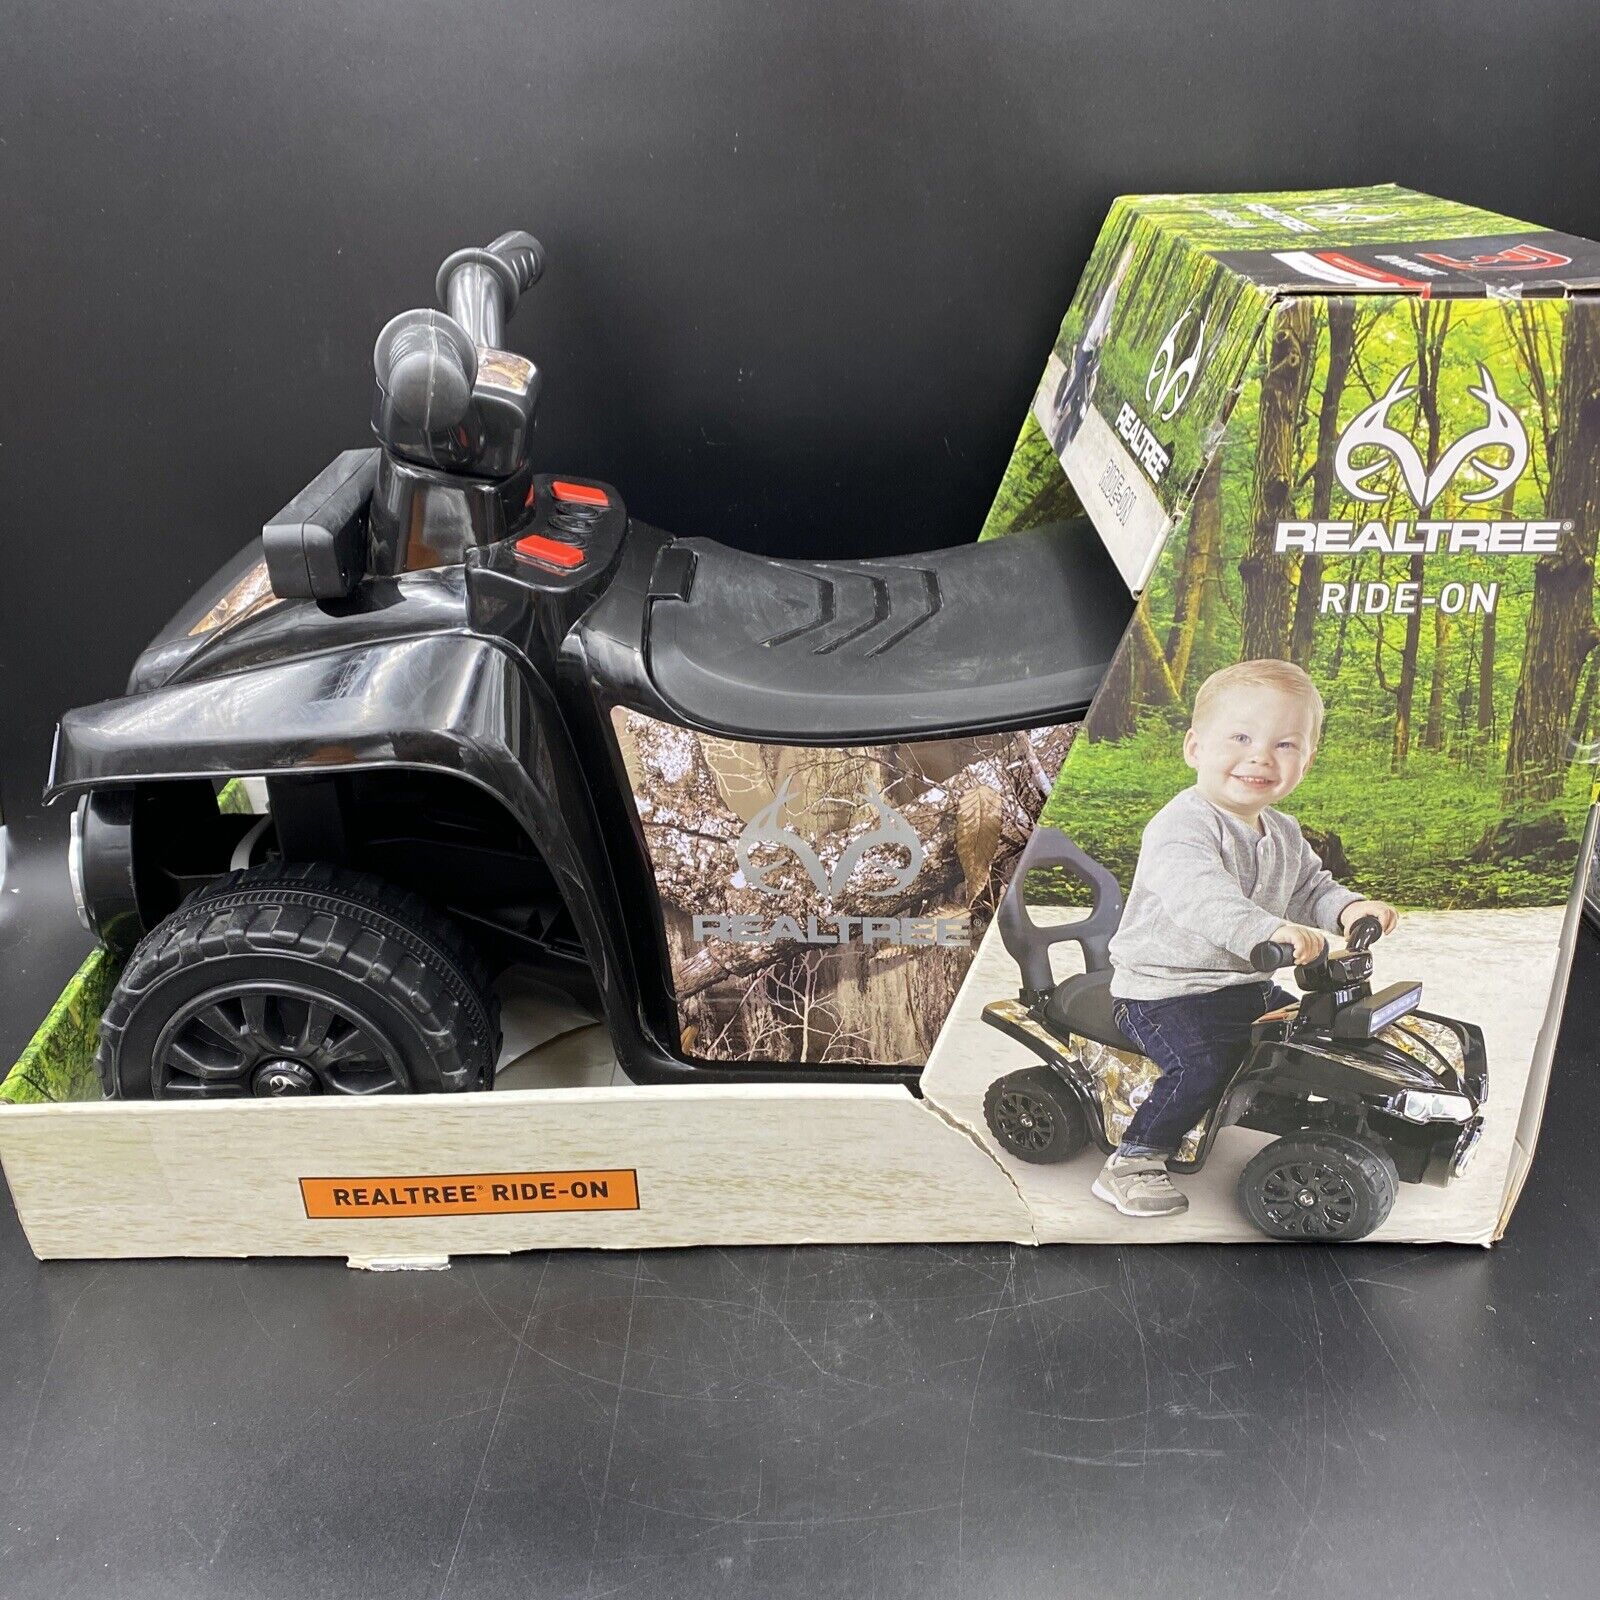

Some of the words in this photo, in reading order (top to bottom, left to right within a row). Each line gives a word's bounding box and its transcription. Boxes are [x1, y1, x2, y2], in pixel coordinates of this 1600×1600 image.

[1114, 400, 1171, 484] REALTREE
[1319, 582, 1498, 614] RIDE-ON
[491, 1180, 609, 1202] RIDE-ON
